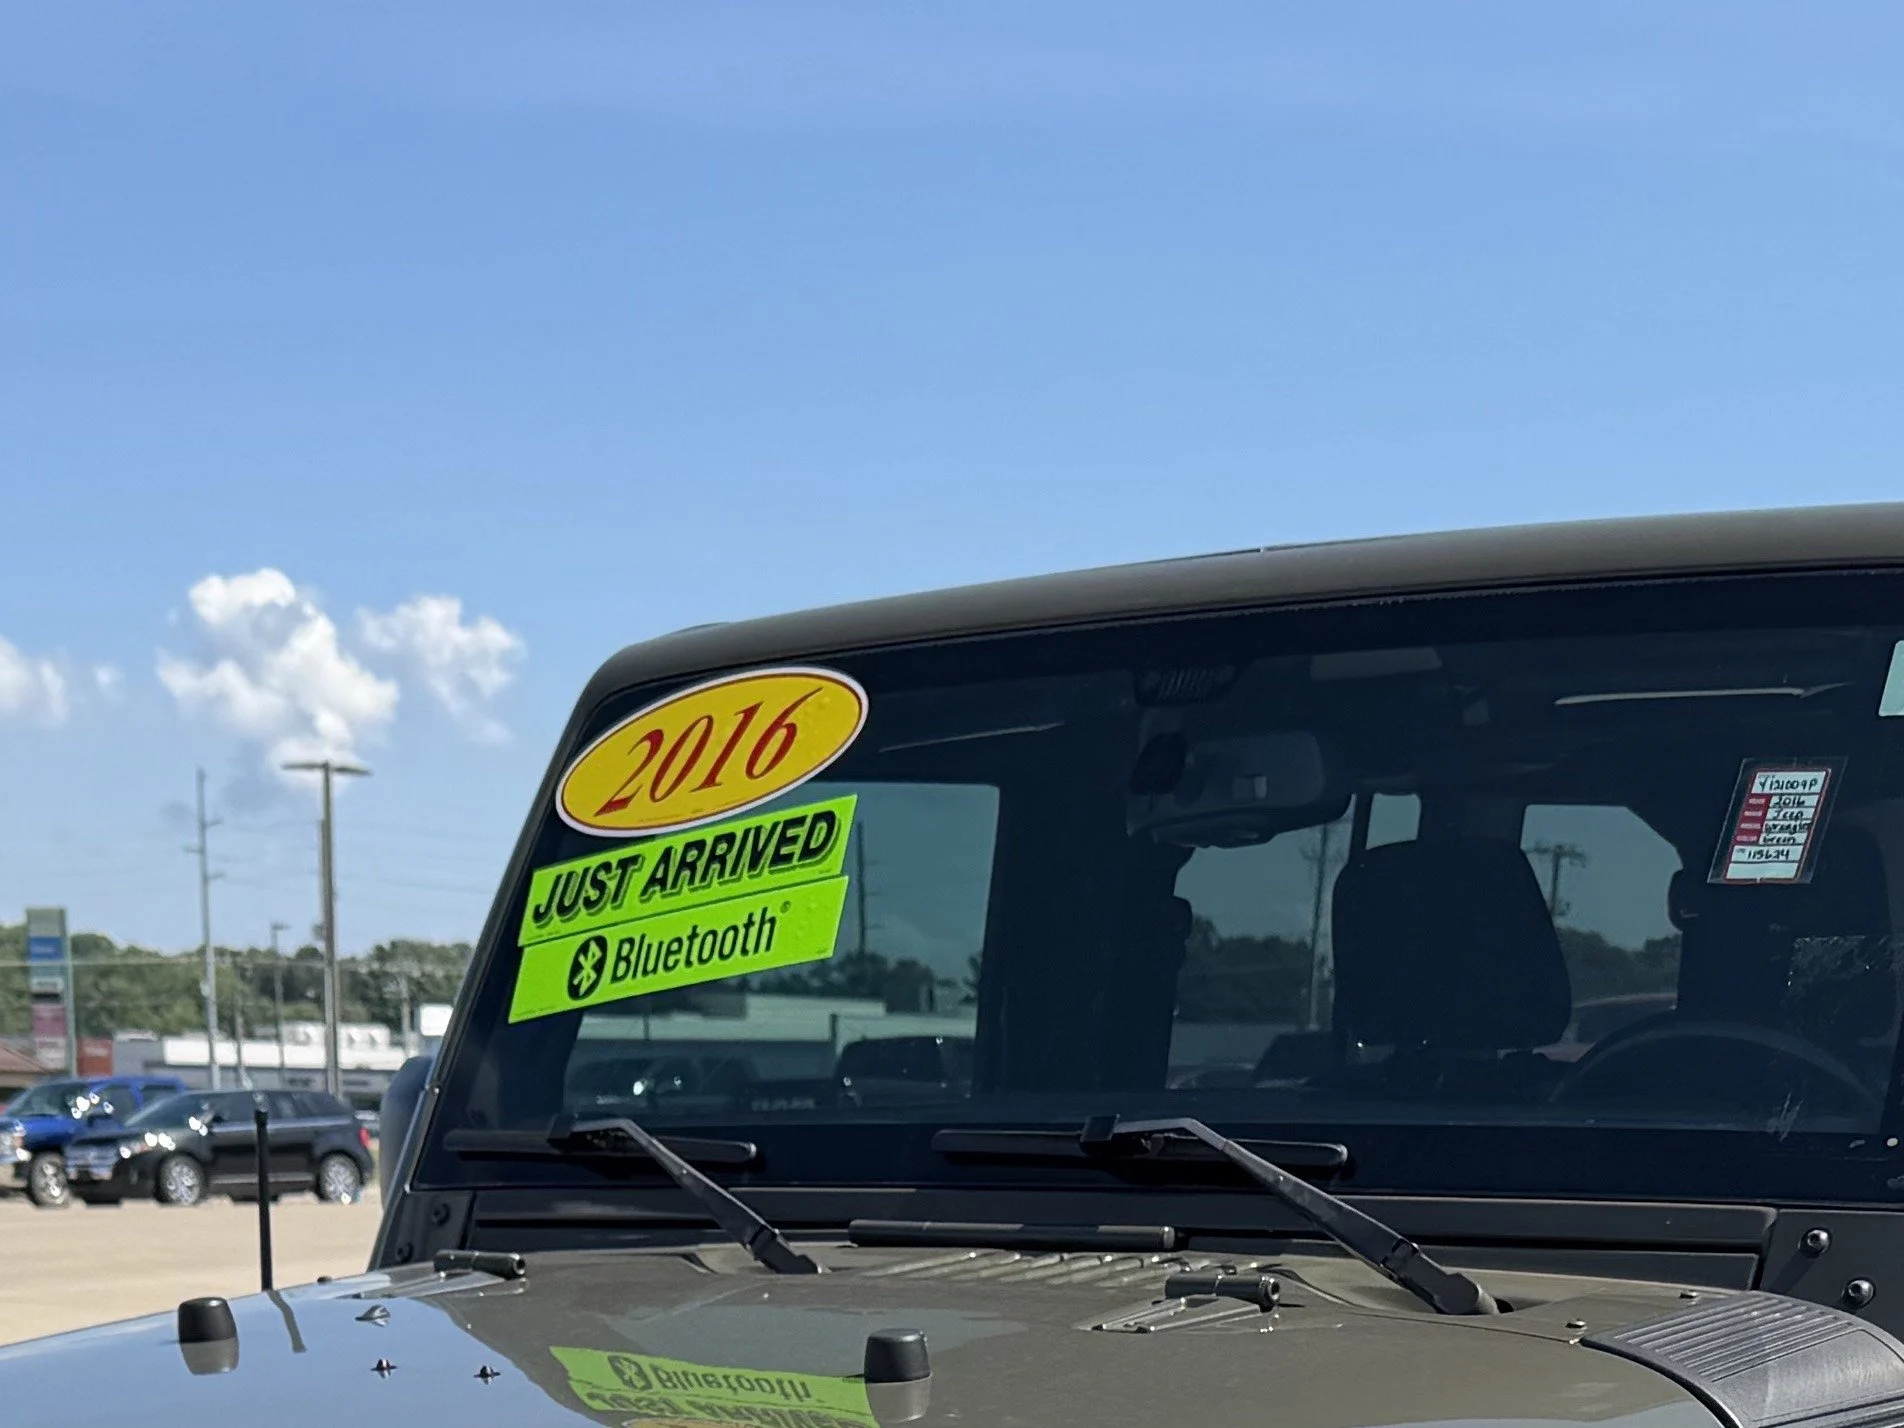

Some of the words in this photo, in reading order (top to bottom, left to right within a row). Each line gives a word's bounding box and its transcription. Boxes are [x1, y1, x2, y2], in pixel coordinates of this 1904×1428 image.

[594, 686, 825, 818] 2016
[533, 853, 646, 928] JUST
[640, 809, 841, 903] ARRIVED
[609, 906, 778, 985] Bluetooth
